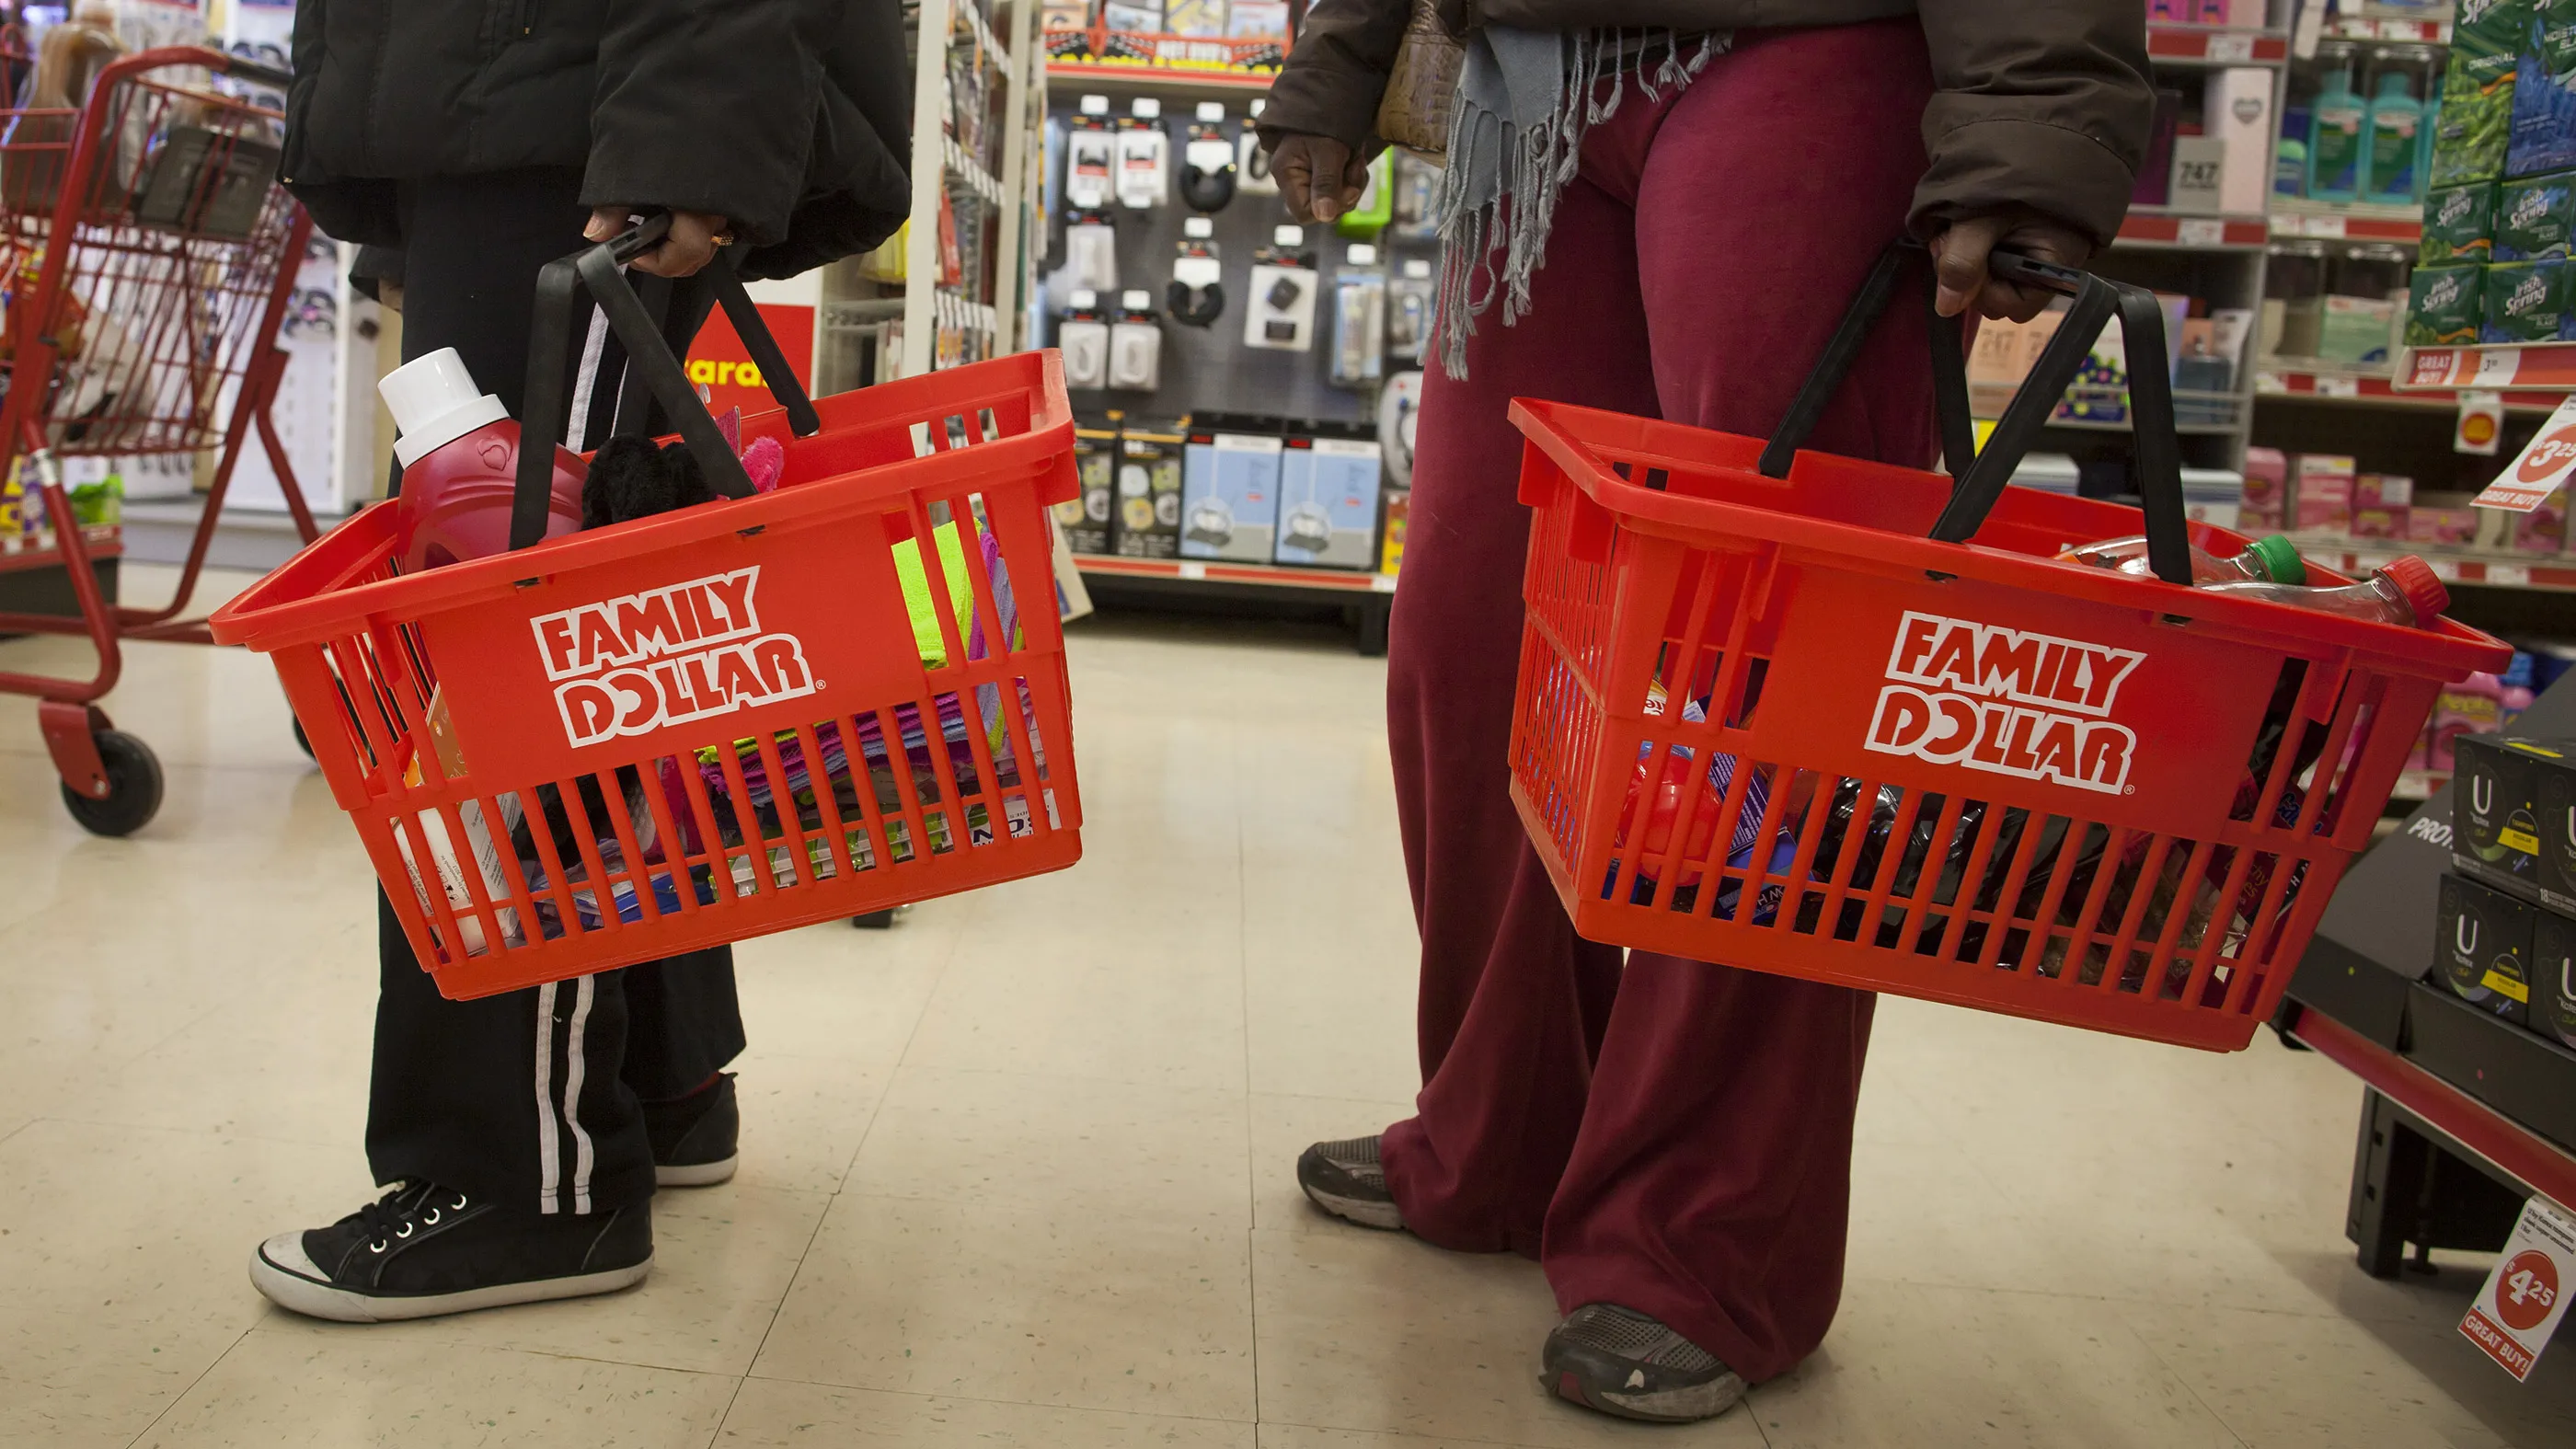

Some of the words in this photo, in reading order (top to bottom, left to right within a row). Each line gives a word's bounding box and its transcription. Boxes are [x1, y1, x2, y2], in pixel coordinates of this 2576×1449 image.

[2509, 198, 2549, 230] Spring
[2519, 188, 2545, 213] Irish
[2505, 285, 2547, 316] Spring
[2515, 276, 2543, 299] Irish
[530, 565, 762, 682] FAMILY
[1885, 610, 2148, 718] FAMILY
[554, 633, 817, 749] DOLLAR
[1864, 684, 2137, 795] DOLLAR
[2472, 775, 2492, 815] U
[2456, 914, 2478, 955] U
[2465, 1315, 2501, 1349] GREAT
[2499, 1342, 2530, 1373] BUY!
